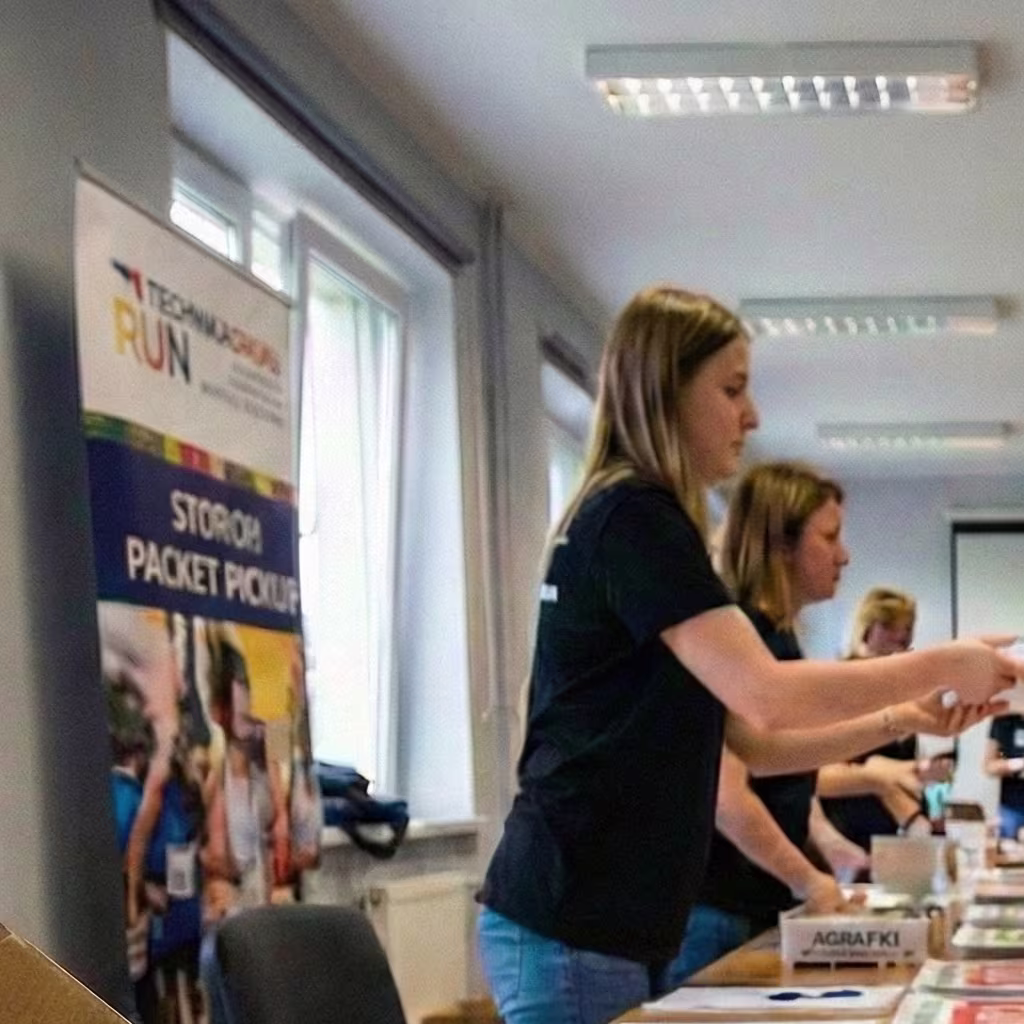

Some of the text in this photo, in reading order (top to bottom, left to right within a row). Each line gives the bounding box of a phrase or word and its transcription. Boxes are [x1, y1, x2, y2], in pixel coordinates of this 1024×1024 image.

[112, 296, 191, 385] RUN
[126, 535, 220, 596] PACKET
[812, 930, 899, 948] AGRAFKI
